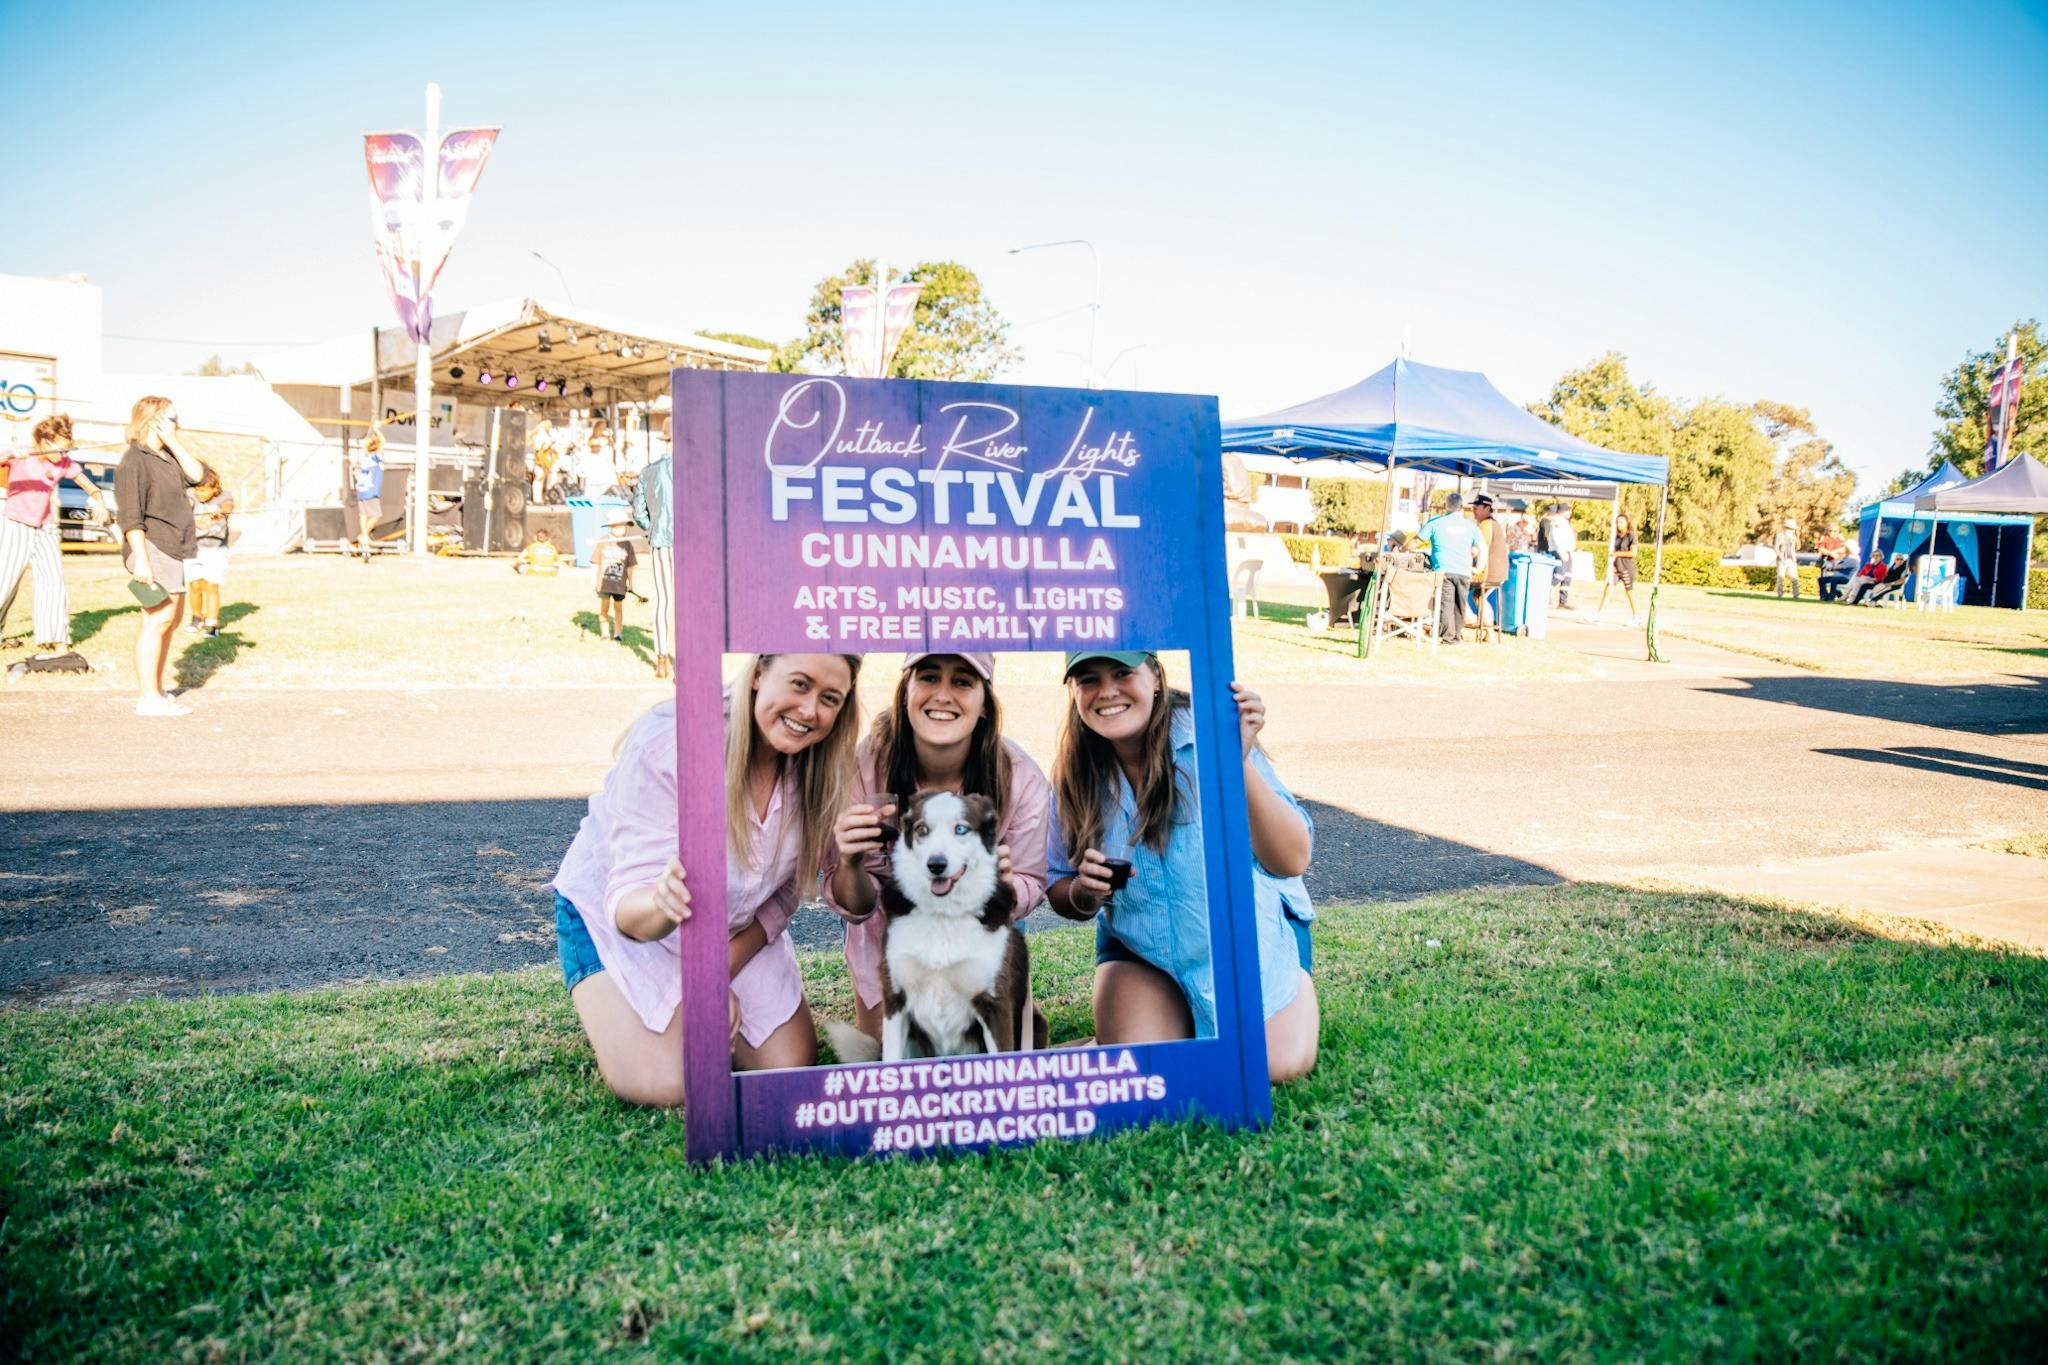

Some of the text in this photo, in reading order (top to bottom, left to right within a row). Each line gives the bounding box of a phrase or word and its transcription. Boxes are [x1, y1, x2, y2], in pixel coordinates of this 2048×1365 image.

[386, 408, 442, 429] Dower
[764, 378, 1140, 484] Outback River Lights
[771, 465, 1141, 528] FESTIVAL
[801, 533, 1115, 570] CUNNAMULLA
[793, 585, 1123, 614] ARTS, MUSIC, LIGHTS
[805, 615, 1115, 639] & FREE FAMILY FUN
[824, 1049, 1138, 1096] #VISITCUNNAMULLA
[795, 1076, 1167, 1128] #OUTBACKRIVERLIGHTS
